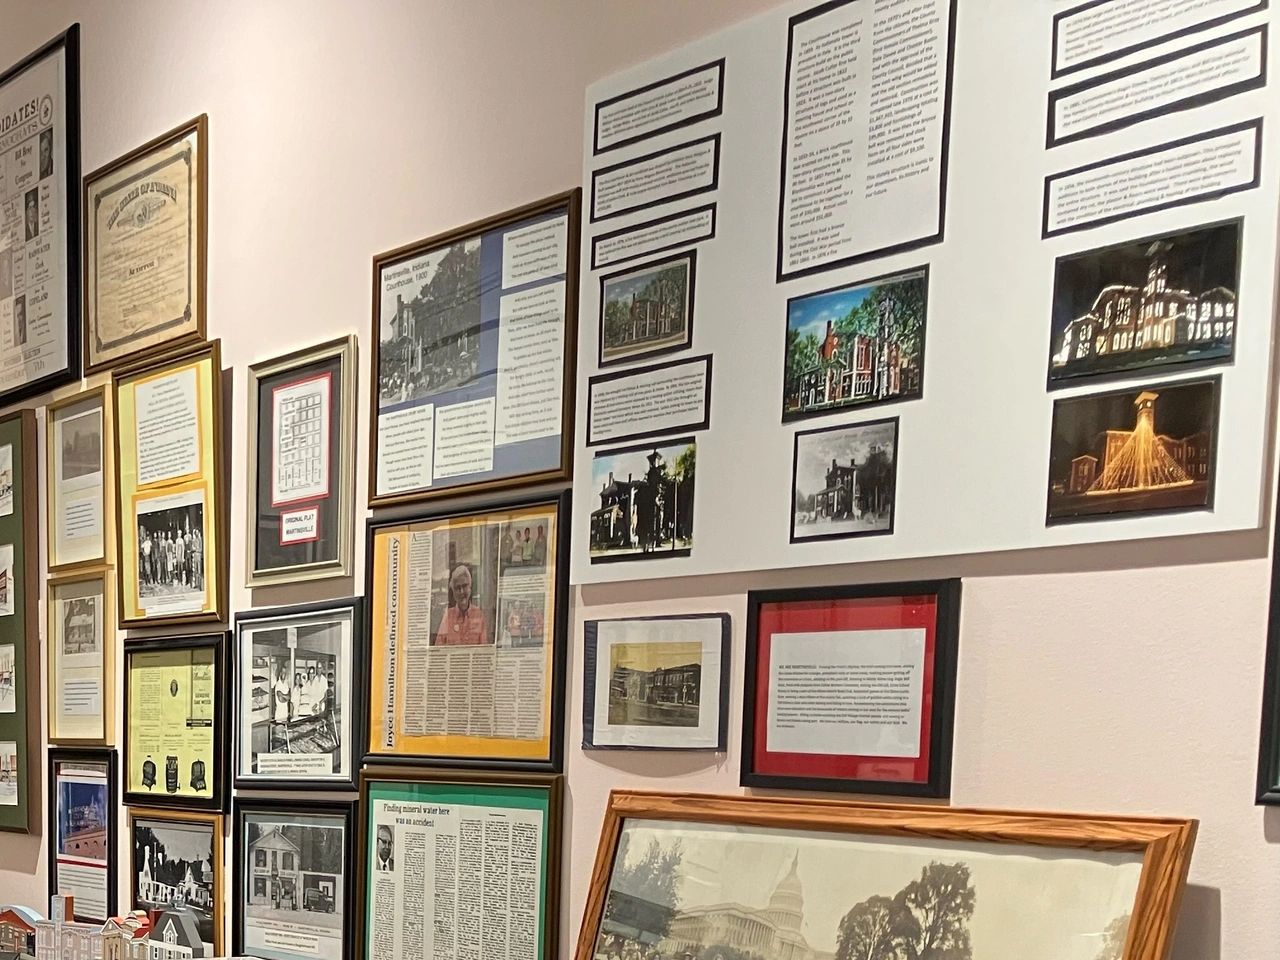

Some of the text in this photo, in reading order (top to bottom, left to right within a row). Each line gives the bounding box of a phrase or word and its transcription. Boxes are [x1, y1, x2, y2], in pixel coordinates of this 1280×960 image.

[386, 537, 401, 748] Joyce Hamilton defined community
[383, 803, 402, 814] Finding
[402, 804, 422, 814] mineral
[423, 806, 438, 815] water
